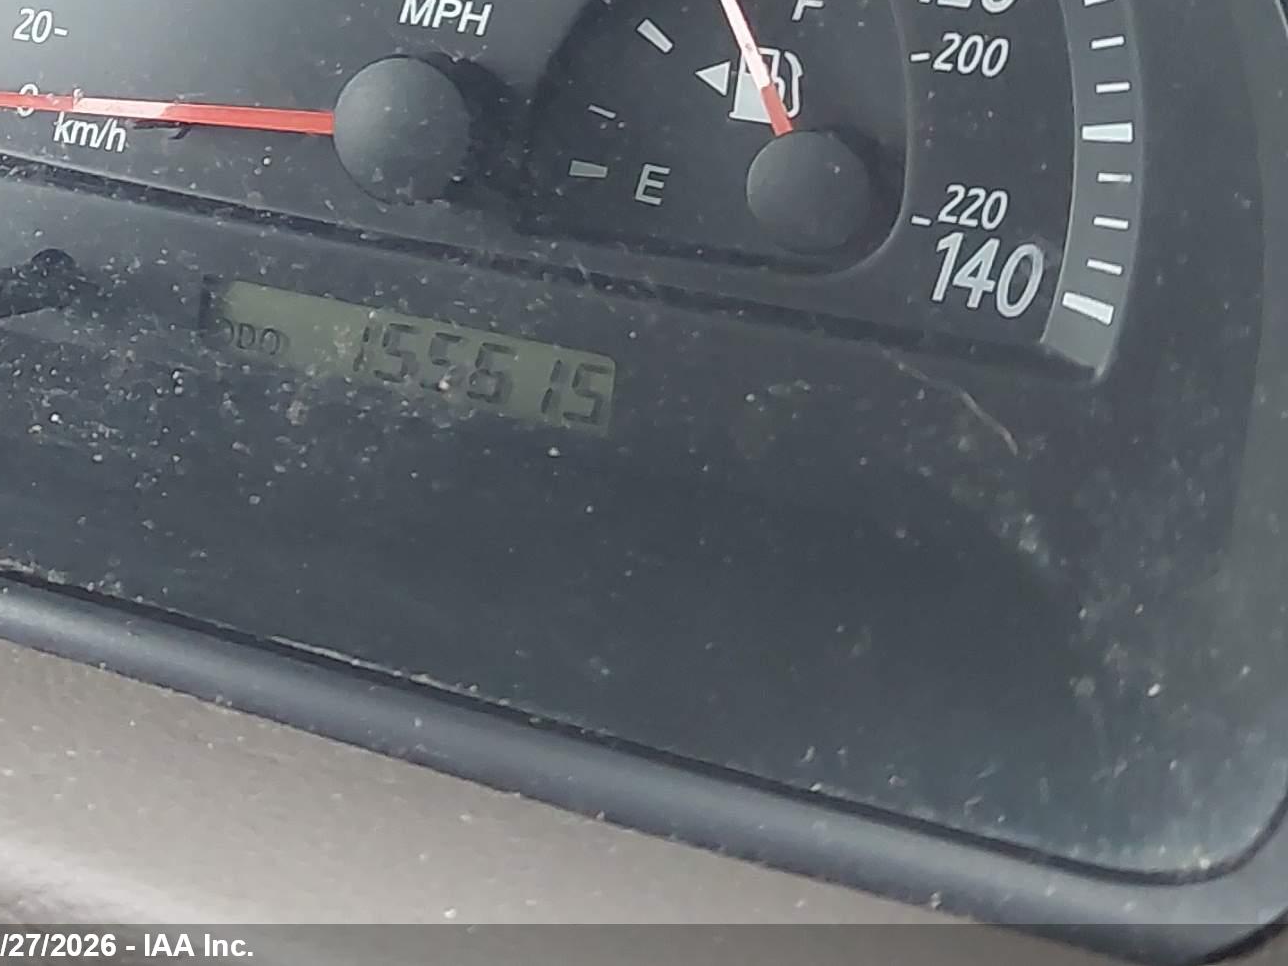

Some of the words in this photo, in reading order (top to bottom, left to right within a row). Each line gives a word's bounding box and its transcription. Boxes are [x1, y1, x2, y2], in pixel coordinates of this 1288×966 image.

[13, 7, 54, 44] 20
[932, 34, 1009, 77] 200
[53, 111, 129, 153] km/h
[635, 163, 670, 205] E
[937, 184, 1009, 230] 220
[932, 231, 1044, 319] 140
